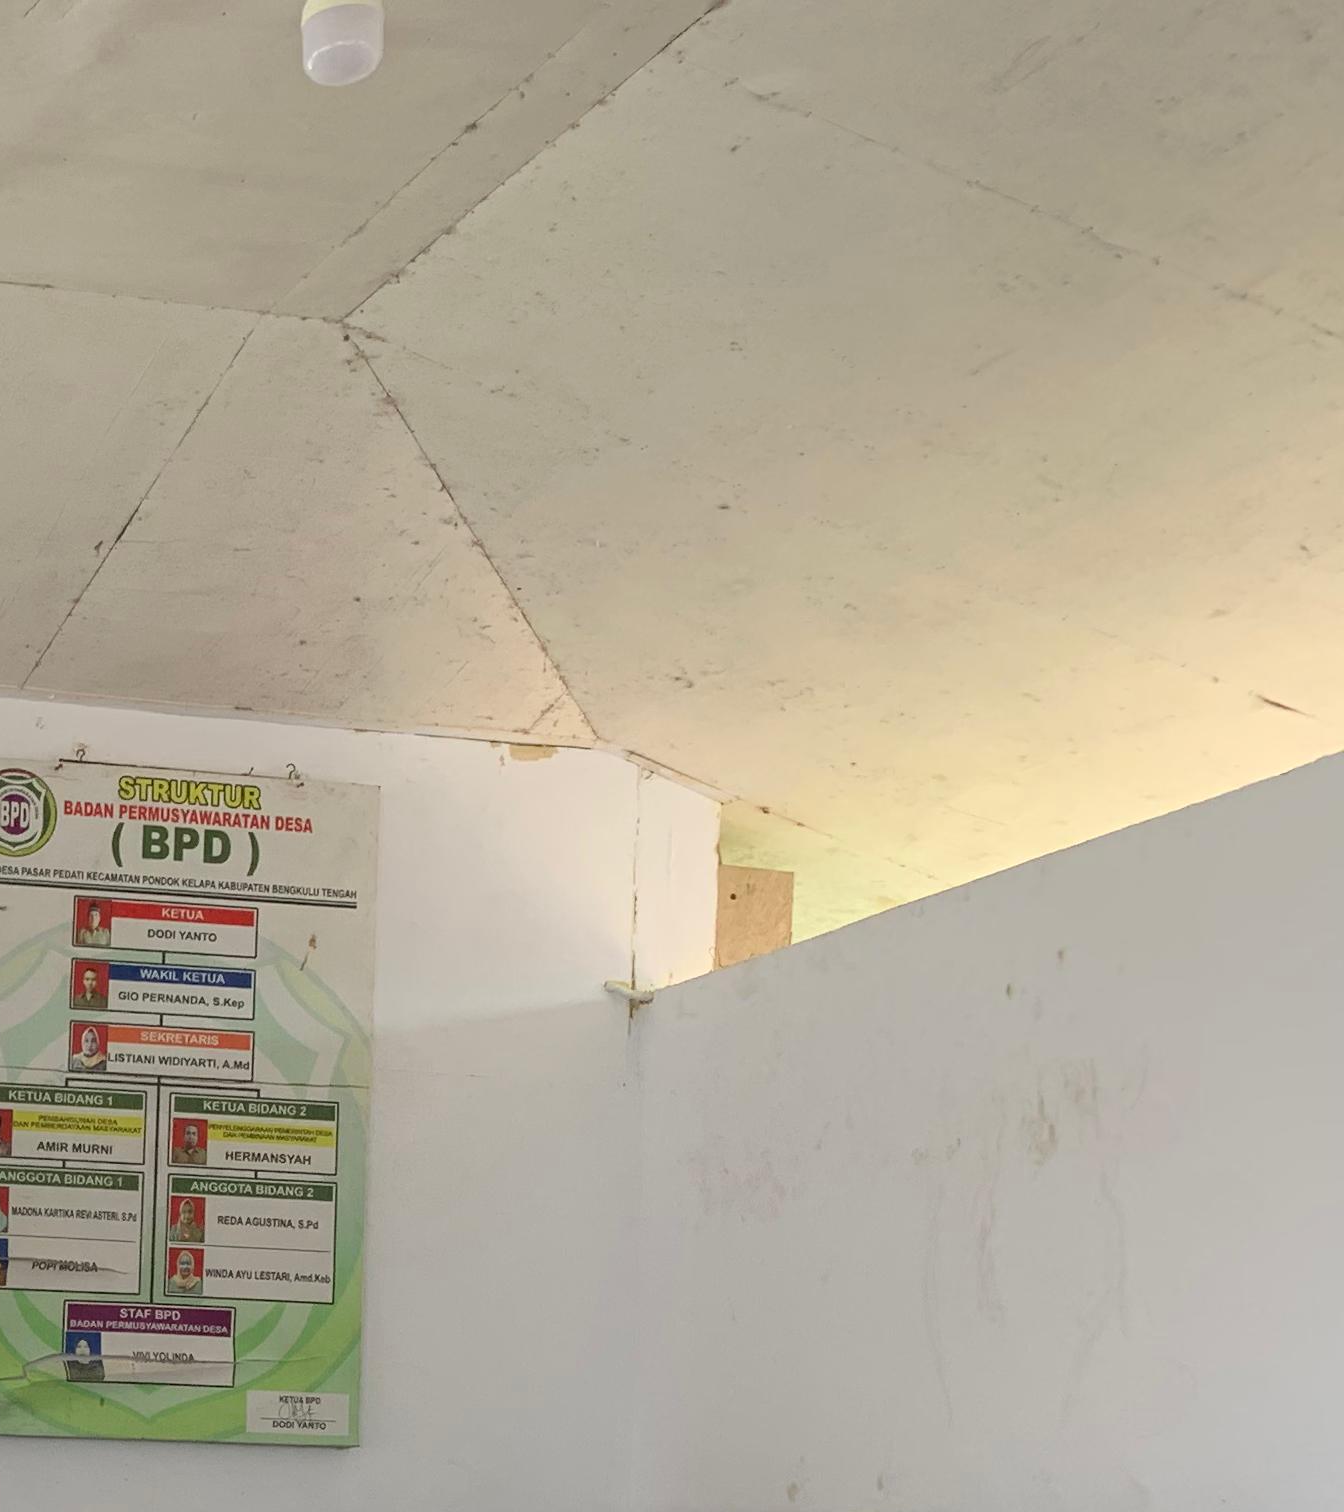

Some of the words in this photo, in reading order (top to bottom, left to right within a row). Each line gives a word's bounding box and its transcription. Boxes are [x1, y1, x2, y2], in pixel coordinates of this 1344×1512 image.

[118, 775, 261, 810] STRUKTUR
[0, 800, 30, 828] BPD
[64, 800, 114, 818] BADAN
[119, 804, 270, 830] PERMUSYAWARATAN
[275, 815, 313, 833] DESA
[21, 866, 51, 878] PASAR
[53, 869, 84, 881] PEDATI
[86, 872, 140, 885] KECAMATAN
[142, 876, 179, 888] PONDOK
[182, 878, 216, 889] KELAPA
[218, 880, 270, 893] KABUPATEN
[272, 884, 319, 897] BENGKULU
[322, 888, 357, 899] TENGAH
[161, 907, 205, 921] KETUA
[147, 928, 176, 939] DODI
[179, 931, 218, 943] YANTO
[140, 968, 179, 981] WAKIL
[183, 971, 226, 984] KETUA
[118, 991, 139, 1001] GIO
[142, 993, 210, 1006] PERNANDA,
[212, 997, 245, 1010] S.Kep
[140, 1031, 220, 1045] SEKRETARIS
[107, 1053, 155, 1065] LISTIANI
[157, 1056, 220, 1069] WIDIYARTI,
[222, 1059, 250, 1071] A.Md
[8, 1090, 52, 1102] KETUA
[54, 1093, 104, 1106] BIDANG
[107, 1096, 113, 1106] 1
[203, 1100, 244, 1112] KETUA
[248, 1104, 297, 1116] BIDANG
[300, 1106, 307, 1117] 2
[97, 1118, 118, 1126] DESA
[36, 1141, 69, 1153] AMIR
[71, 1143, 113, 1155] MURNI
[225, 1151, 312, 1166] HERMANSYAH
[64, 1174, 113, 1187] BIDANG
[117, 1177, 123, 1187] 1
[190, 1181, 252, 1195] ANGGOTA
[255, 1184, 304, 1197] BIDANG
[306, 1187, 314, 1198] 2
[12, 1205, 43, 1217] MADONA
[44, 1207, 75, 1219] KARTIKA
[217, 1215, 244, 1226] REDA
[245, 1217, 295, 1230] AGUSTINA,
[297, 1219, 319, 1230] S.Pd
[31, 1260, 57, 1271] POPI
[59, 1261, 98, 1273] MOLISA
[205, 1268, 234, 1279] WINDA
[235, 1269, 253, 1280] AYU
[254, 1271, 292, 1283] LESTARI,
[119, 1308, 152, 1319] STAF
[155, 1309, 181, 1321] BPD
[70, 1319, 104, 1329] BADAN
[105, 1321, 202, 1333] PERMUSYAWARATAN
[203, 1325, 229, 1334] DESA
[279, 1395, 304, 1404] KETUA
[272, 1420, 295, 1429] DODI
[297, 1421, 327, 1430] YANTO
